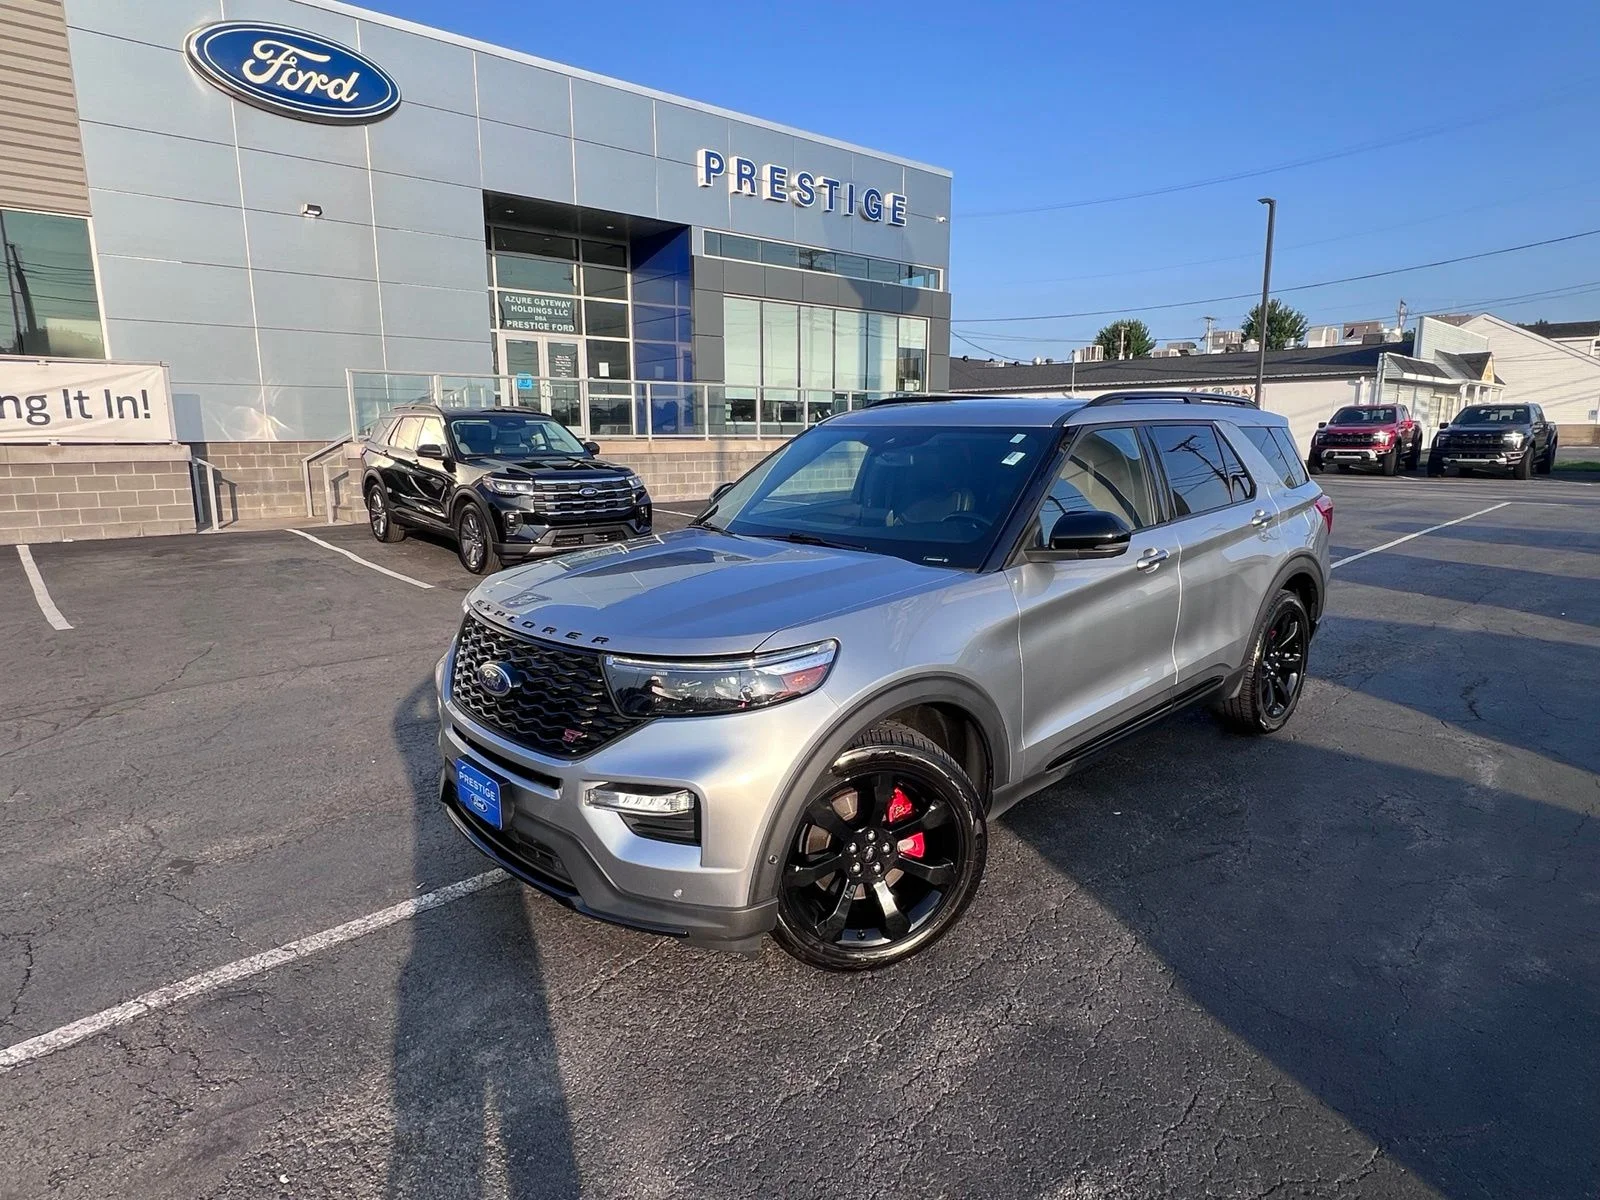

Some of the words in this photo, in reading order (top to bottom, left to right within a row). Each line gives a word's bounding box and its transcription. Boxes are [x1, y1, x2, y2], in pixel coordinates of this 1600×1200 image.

[242, 39, 360, 103] Ford
[697, 149, 907, 227] PRESTIGE
[504, 295, 533, 305] AZURE
[534, 298, 572, 309] GATEWAY
[510, 305, 553, 316] HOLDINGS
[554, 309, 569, 317] LLC
[506, 320, 550, 331] PRESTIGE
[551, 323, 575, 333] FORD
[0, 394, 51, 426] ng
[62, 389, 92, 419] It
[104, 389, 151, 419] In!
[475, 600, 610, 645] EXPLORER
[562, 728, 584, 743] ST
[458, 770, 496, 802] PRESTIGE
